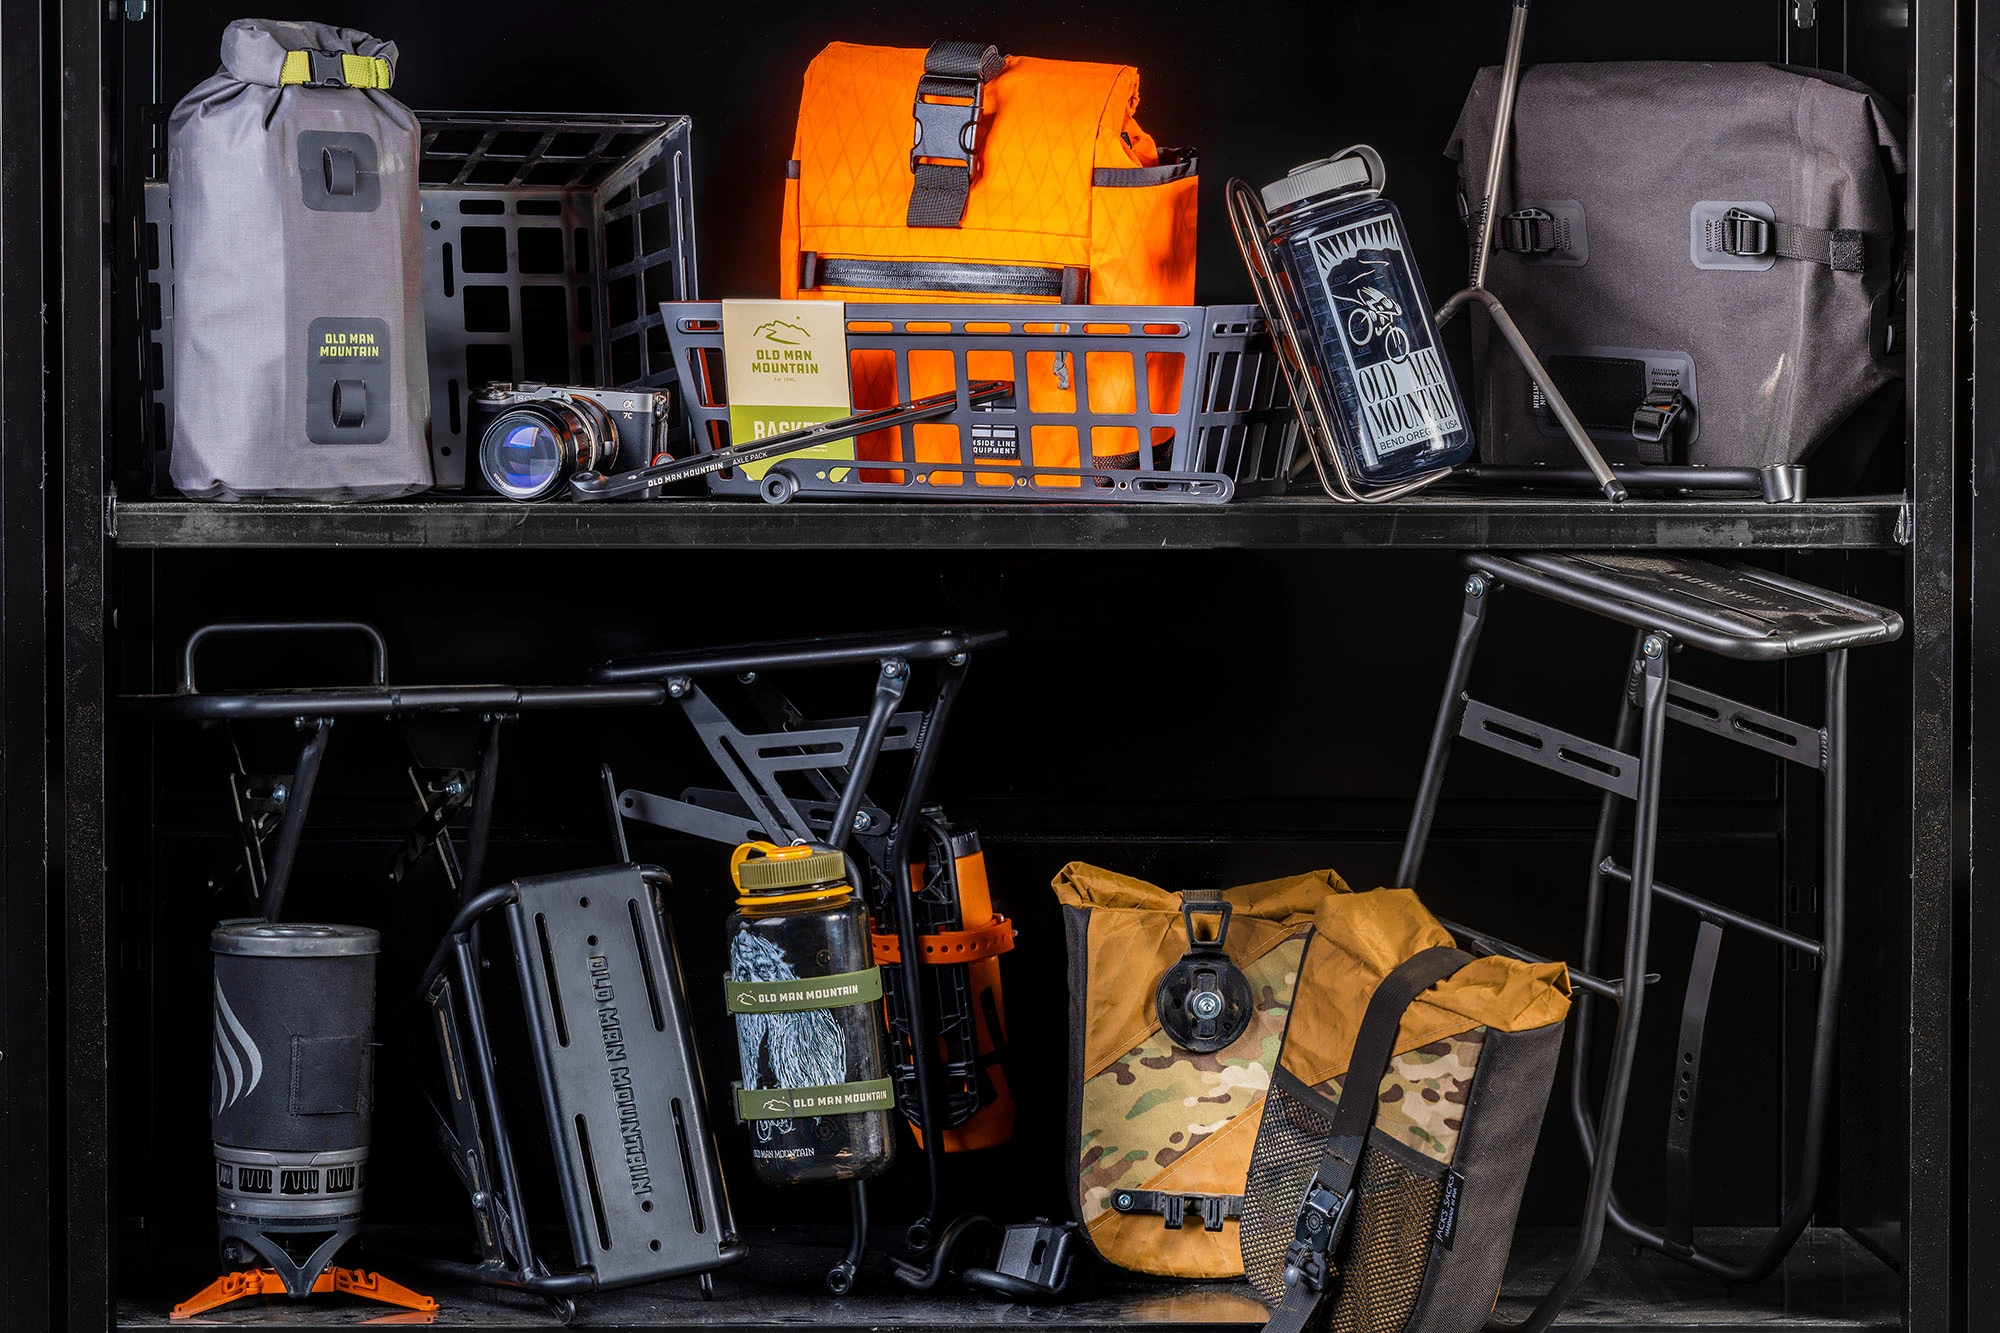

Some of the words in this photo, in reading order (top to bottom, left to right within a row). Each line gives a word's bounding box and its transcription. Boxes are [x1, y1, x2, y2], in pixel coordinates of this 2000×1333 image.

[325, 333, 347, 344] OLD
[349, 333, 374, 344] MAN
[320, 346, 379, 357] MOUNTAIN
[756, 349, 780, 360] OLD
[783, 350, 812, 360] MAN
[751, 362, 819, 374] MOUNTAIN
[1359, 363, 1398, 404] OLD
[1408, 348, 1446, 389] MAN
[623, 412, 633, 420] 7C
[1368, 383, 1457, 440] MOUNTAIN
[753, 421, 823, 441] BAS
[1379, 436, 1405, 451] BEND
[1406, 424, 1446, 442] OREGN,
[1445, 419, 1460, 430] USA
[973, 447, 1016, 455] QUIPMENT
[997, 440, 1016, 448] LINE
[648, 477, 663, 488] OLD
[664, 472, 683, 484] MAN
[683, 462, 724, 478] MOUNTAIN
[732, 456, 750, 466] AXLE
[750, 451, 769, 461] PACK
[587, 955, 615, 1003] OLD
[758, 993, 777, 1003] OLD
[780, 991, 804, 1002] MAN
[806, 984, 859, 1000] MOUNTAIN
[598, 1007, 627, 1063] MAN
[793, 1098, 815, 1108] OLD
[818, 1096, 842, 1106] MAN
[844, 1090, 887, 1104] MOUNTAIN
[610, 1066, 653, 1196] MOUNTAIN
[774, 1147, 815, 1158] MOUNTAIN
[1444, 1174, 1455, 1207] SACKS
